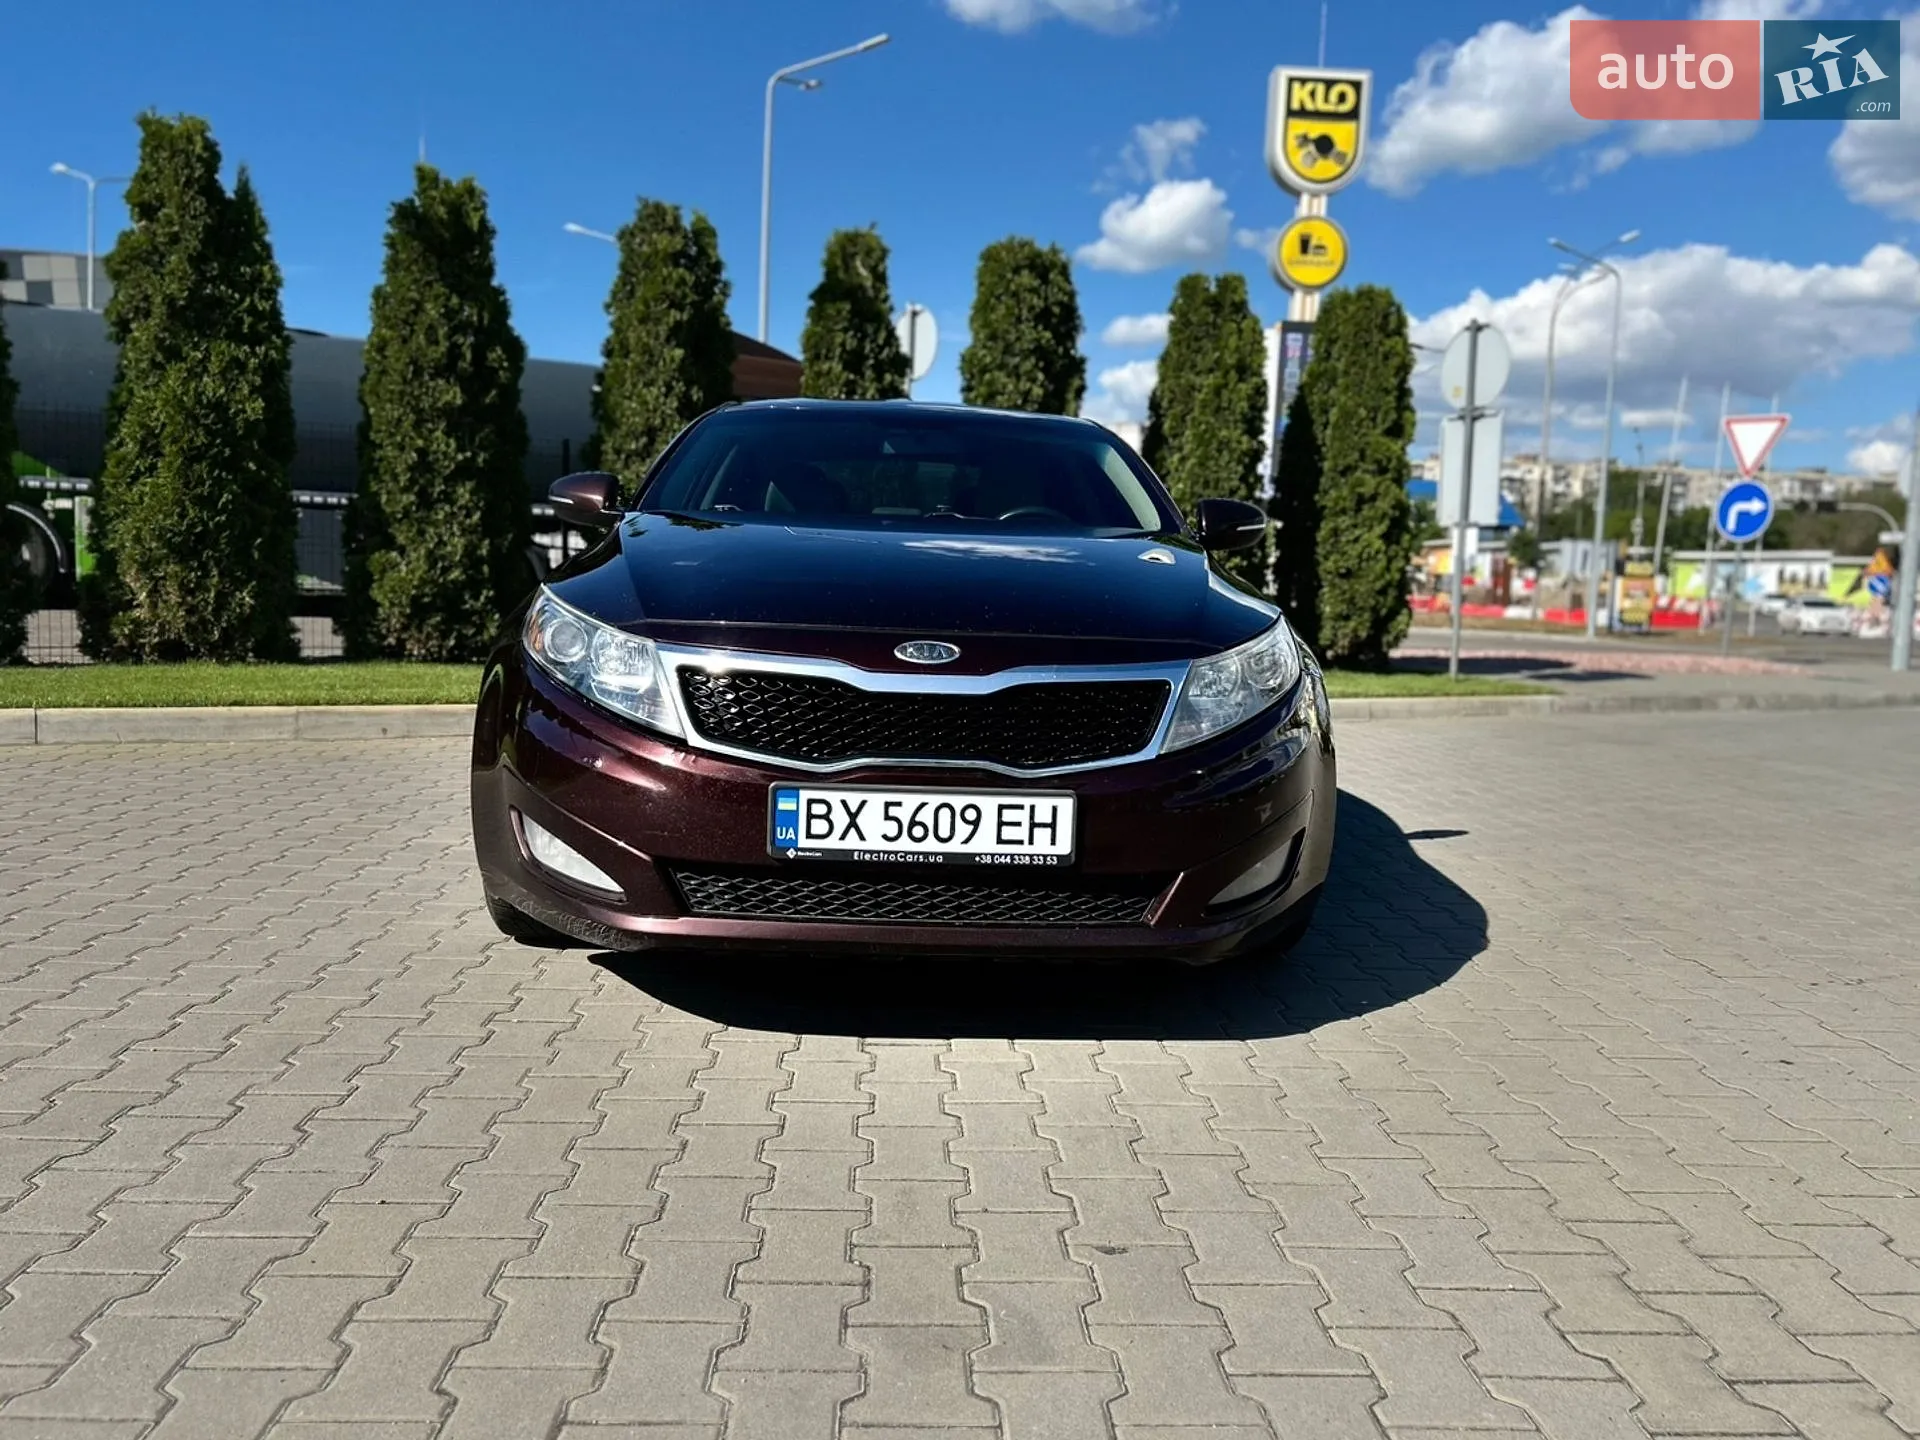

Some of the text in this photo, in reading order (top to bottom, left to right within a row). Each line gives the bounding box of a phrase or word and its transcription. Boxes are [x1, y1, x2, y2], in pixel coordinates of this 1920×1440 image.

[1289, 80, 1358, 113] KLO
[906, 643, 948, 657] KIA
[805, 797, 1059, 846] BX 5609 EH
[776, 826, 796, 841] UA
[853, 850, 944, 863] ElectroCars.ua
[974, 854, 1058, 866] +38 044 338 33 53
